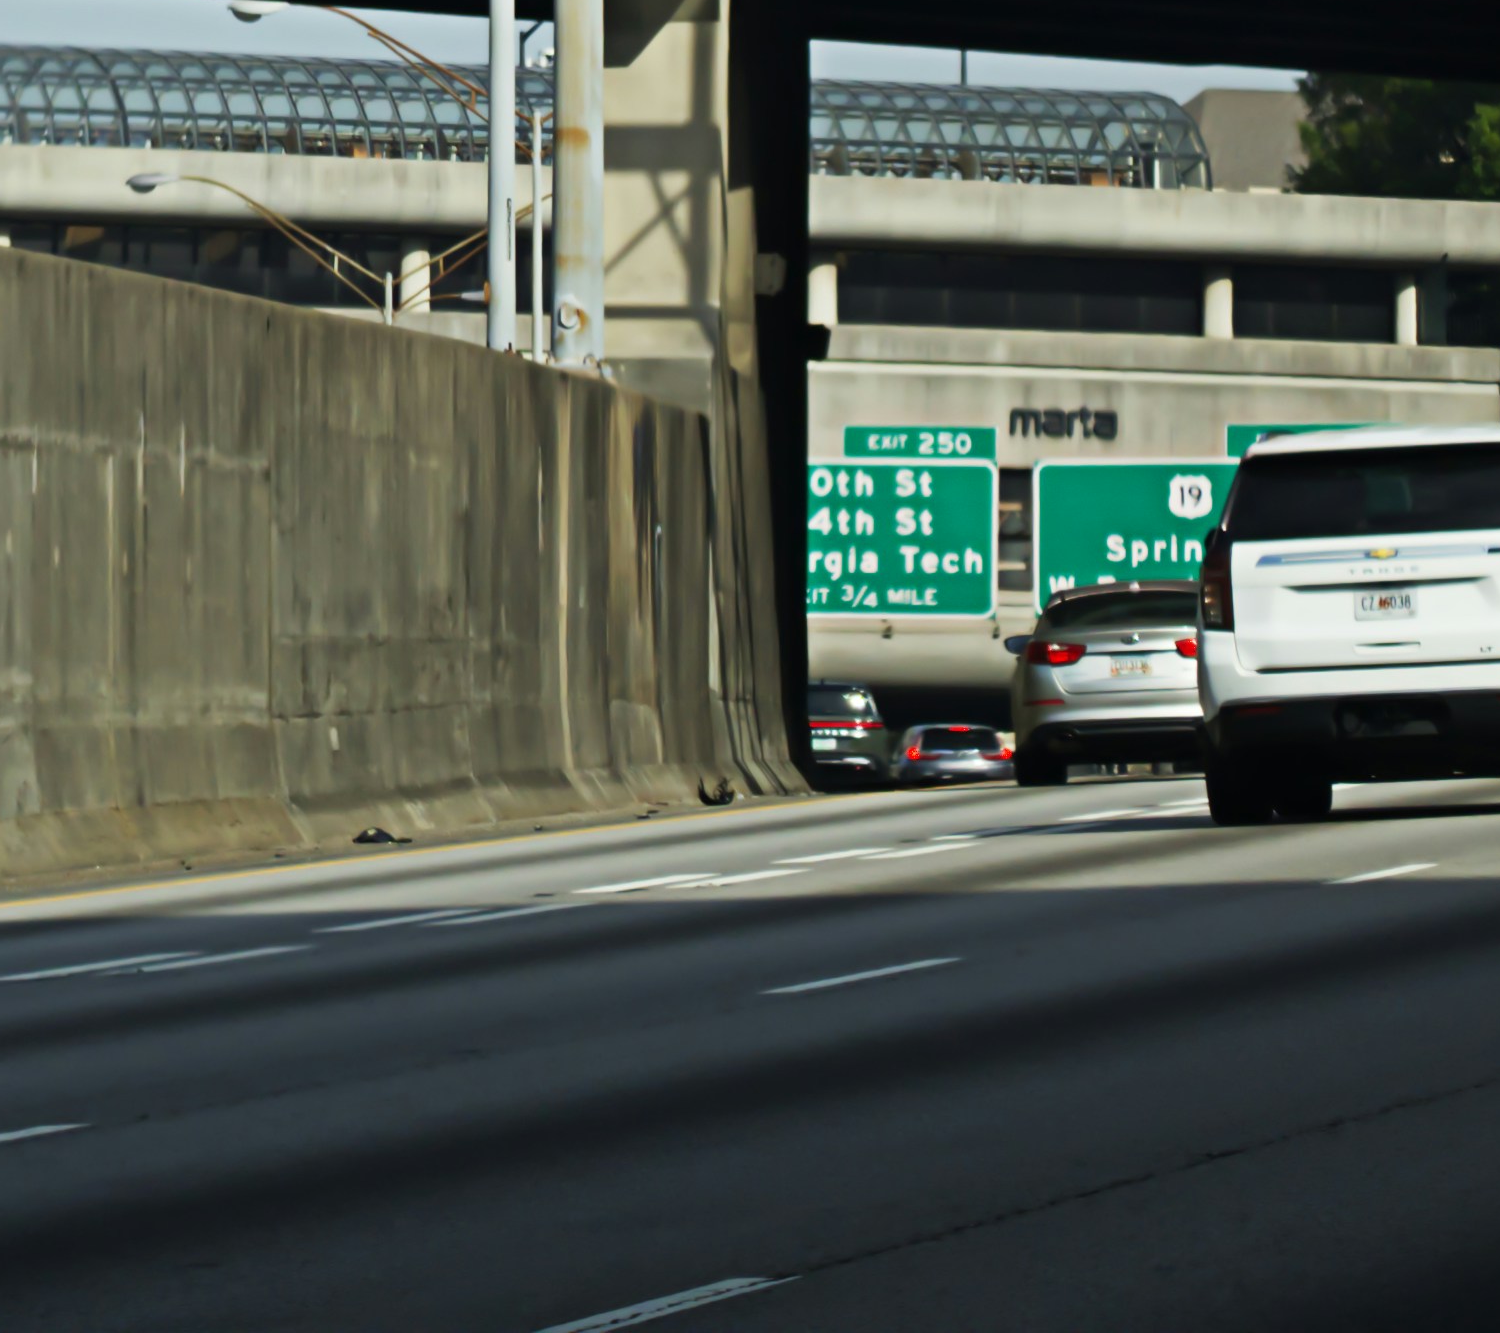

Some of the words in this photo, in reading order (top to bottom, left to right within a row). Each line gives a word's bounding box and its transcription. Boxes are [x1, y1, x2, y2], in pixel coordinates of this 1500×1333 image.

[1009, 406, 1119, 441] marta
[867, 434, 909, 450] EXIT
[918, 432, 973, 455] 250
[895, 469, 933, 497] St
[1179, 485, 1204, 508] 19
[895, 507, 934, 537] St
[899, 545, 984, 575] Tech
[887, 588, 938, 606] MILE
